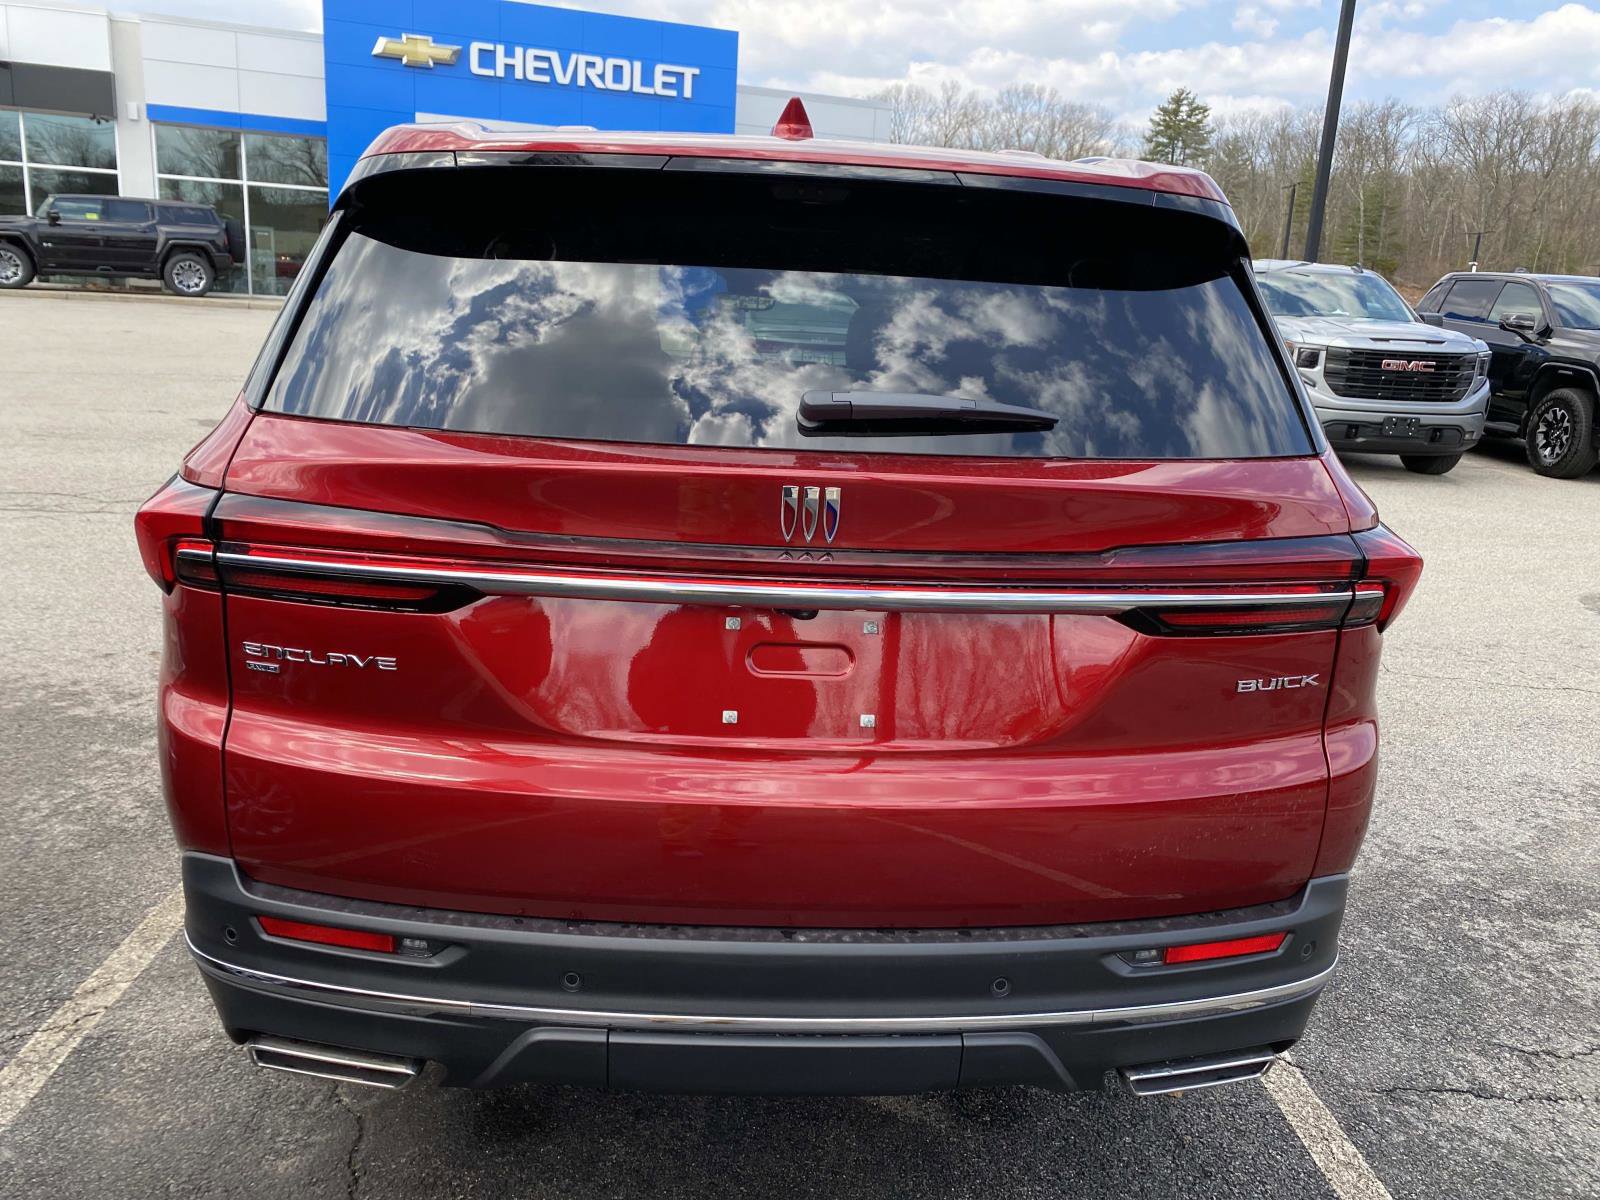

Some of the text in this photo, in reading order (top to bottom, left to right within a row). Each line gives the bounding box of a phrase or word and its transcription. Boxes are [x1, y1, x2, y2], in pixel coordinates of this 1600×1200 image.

[469, 41, 700, 99] CHEVROLET
[1381, 359, 1436, 373] GMC
[242, 641, 398, 671] ENCLAVE
[1237, 673, 1320, 693] BUICK
